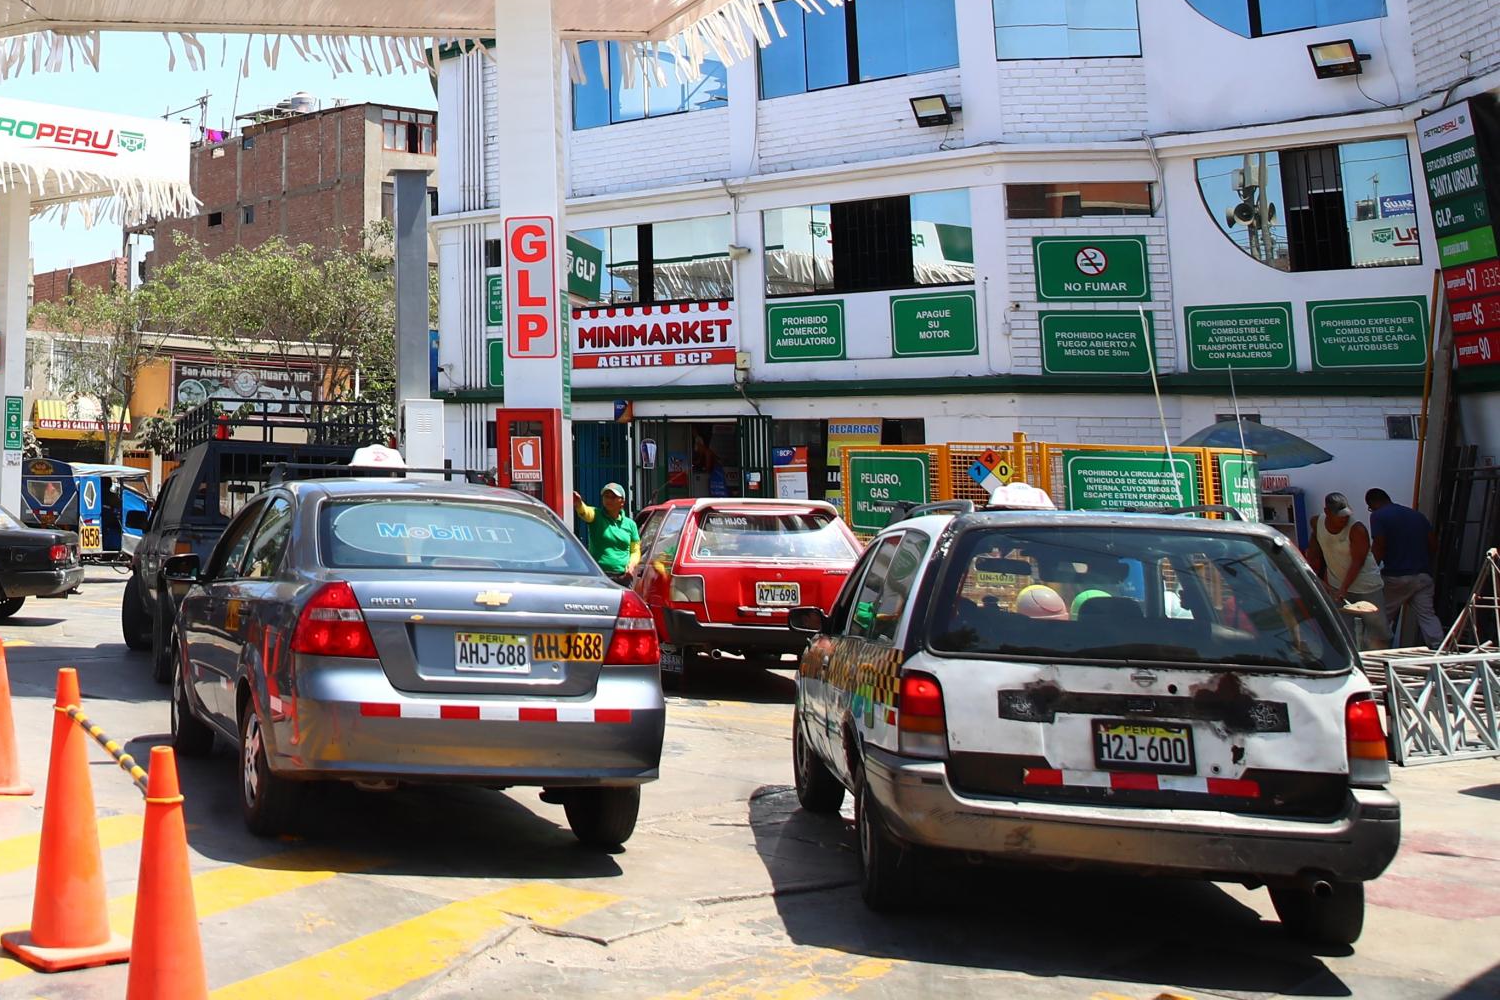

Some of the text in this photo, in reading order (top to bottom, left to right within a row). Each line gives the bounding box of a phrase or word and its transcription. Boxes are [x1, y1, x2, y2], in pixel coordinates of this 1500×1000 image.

[1424, 119, 1457, 138] PETROPERU
[1435, 207, 1451, 228] GLP
[575, 255, 596, 282] GLP
[1465, 268, 1477, 292] 97
[511, 225, 548, 352] GLP
[1064, 281, 1128, 292] NO FUMAR
[916, 309, 951, 319] APAGUE
[1472, 302, 1485, 325] 95
[782, 316, 828, 325] PROHIBIDO
[928, 320, 940, 328] SU
[1196, 318, 1281, 328] PROHIBIDO EXPENDER
[1320, 316, 1414, 328] PROHIBIDO EXPENDER
[578, 318, 732, 349] MINIMARKET
[783, 326, 828, 336] COMERCIO
[919, 330, 950, 339] MOTOR
[1211, 326, 1265, 336] COMBUSTIBLE
[1335, 325, 1395, 335] COMBUSTIBLE
[1055, 331, 1137, 341] PROHIBIDO HACER
[1208, 334, 1270, 344] A VEHICULOS DE
[1322, 333, 1416, 345] VEHICULOS DE CARGA
[775, 336, 836, 347] AMBULATORIO
[1056, 340, 1137, 349] FUEGO ABIERTO A
[1197, 342, 1283, 352] TRANSPORTE PUBLICO
[1347, 342, 1399, 352] AUTOBUSES
[1479, 336, 1491, 360] 90
[1064, 348, 1130, 358] MENOS DE 50m
[1208, 350, 1272, 359] CON PASAJEROS
[597, 352, 713, 368] AGENTE BCP
[181, 366, 197, 376] San
[73, 422, 99, 430] GALLINA
[830, 424, 879, 433] RECARGAS
[985, 453, 993, 463] 4
[975, 466, 1008, 476] 1 0
[861, 473, 901, 486] PELIGRO,
[870, 488, 889, 498] GAS
[376, 523, 474, 541] Mobil
[81, 528, 100, 547] 1958
[978, 574, 1015, 583] UN-1075
[759, 589, 797, 601] A7V-698
[479, 635, 505, 643] PERU
[459, 643, 527, 666] AHJ-688
[1124, 725, 1156, 735] PERU
[1100, 733, 1186, 764] H2J-600
